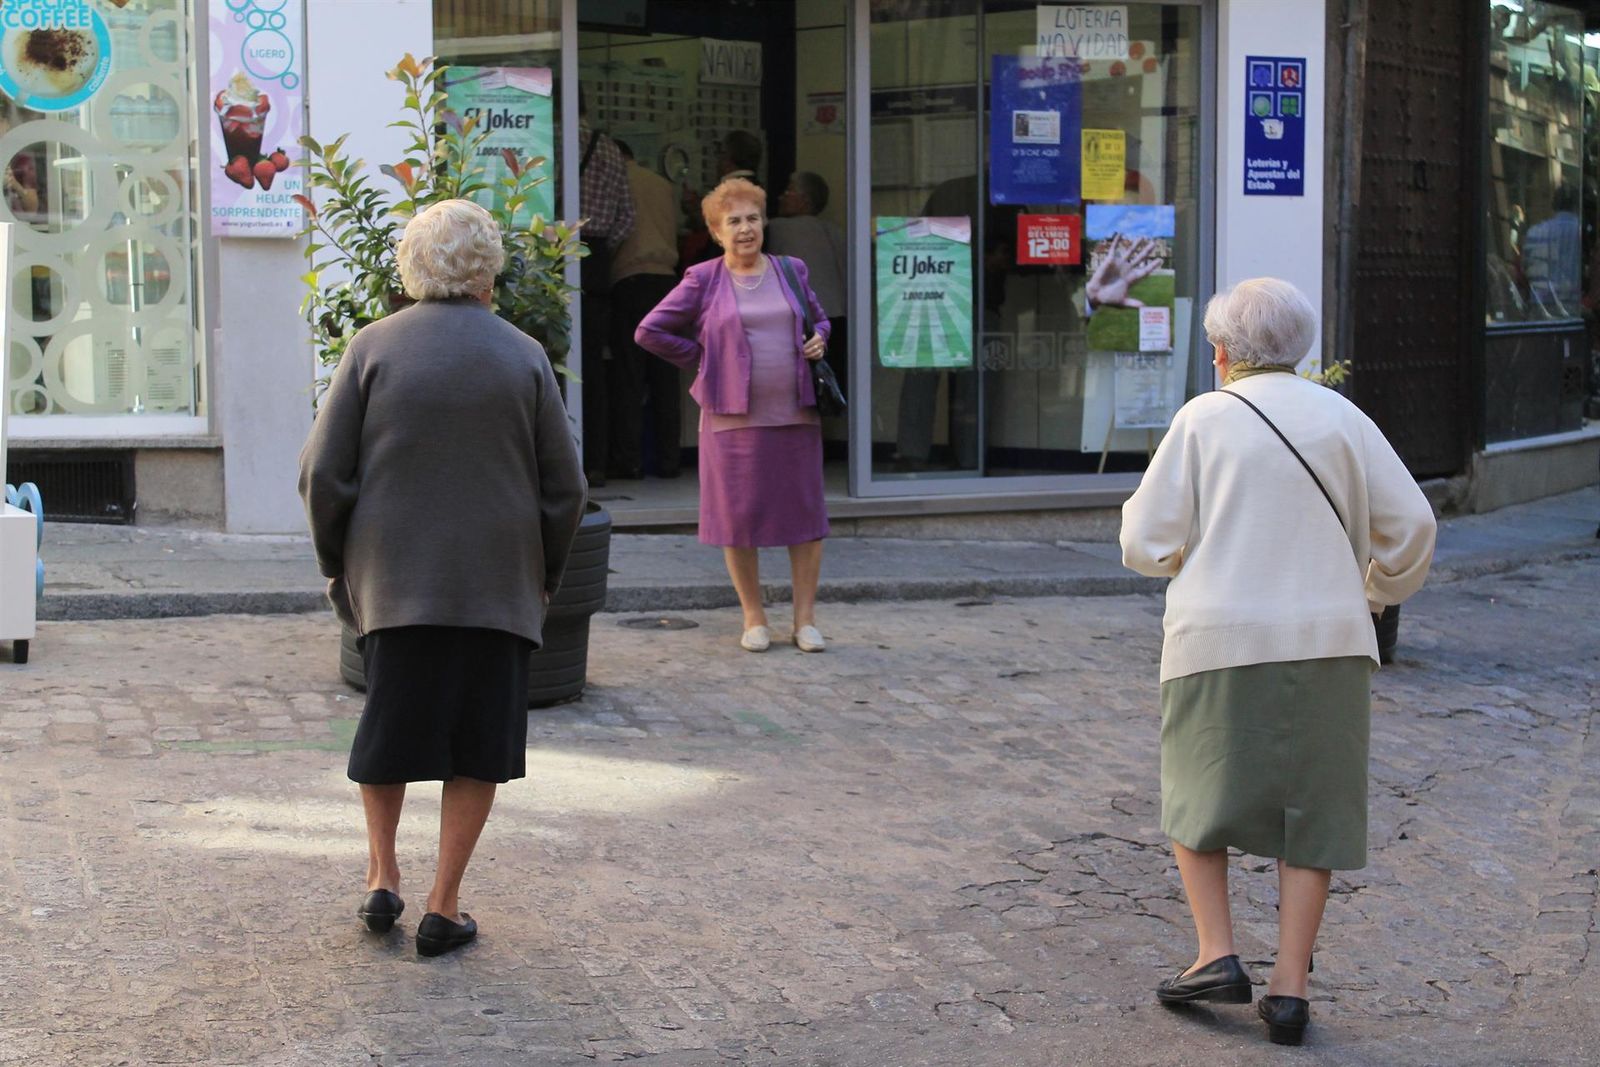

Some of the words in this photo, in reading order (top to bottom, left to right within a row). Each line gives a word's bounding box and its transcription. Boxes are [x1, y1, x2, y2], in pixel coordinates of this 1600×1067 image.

[4, 9, 90, 27] COFFEE
[1055, 7, 1122, 30] LOTERIA
[1039, 33, 1127, 57] NAVIDAD
[250, 48, 286, 60] LIGERO
[482, 107, 535, 134] Joker
[1282, 160, 1289, 170] y
[1247, 169, 1286, 181] Apuestas
[1286, 169, 1300, 179] del
[283, 180, 301, 190] UN
[1247, 179, 1276, 190] Estado
[255, 193, 298, 204] HELAD
[212, 207, 301, 217] SORPRENDENTE
[893, 255, 908, 275] El
[908, 255, 956, 280] Joker
